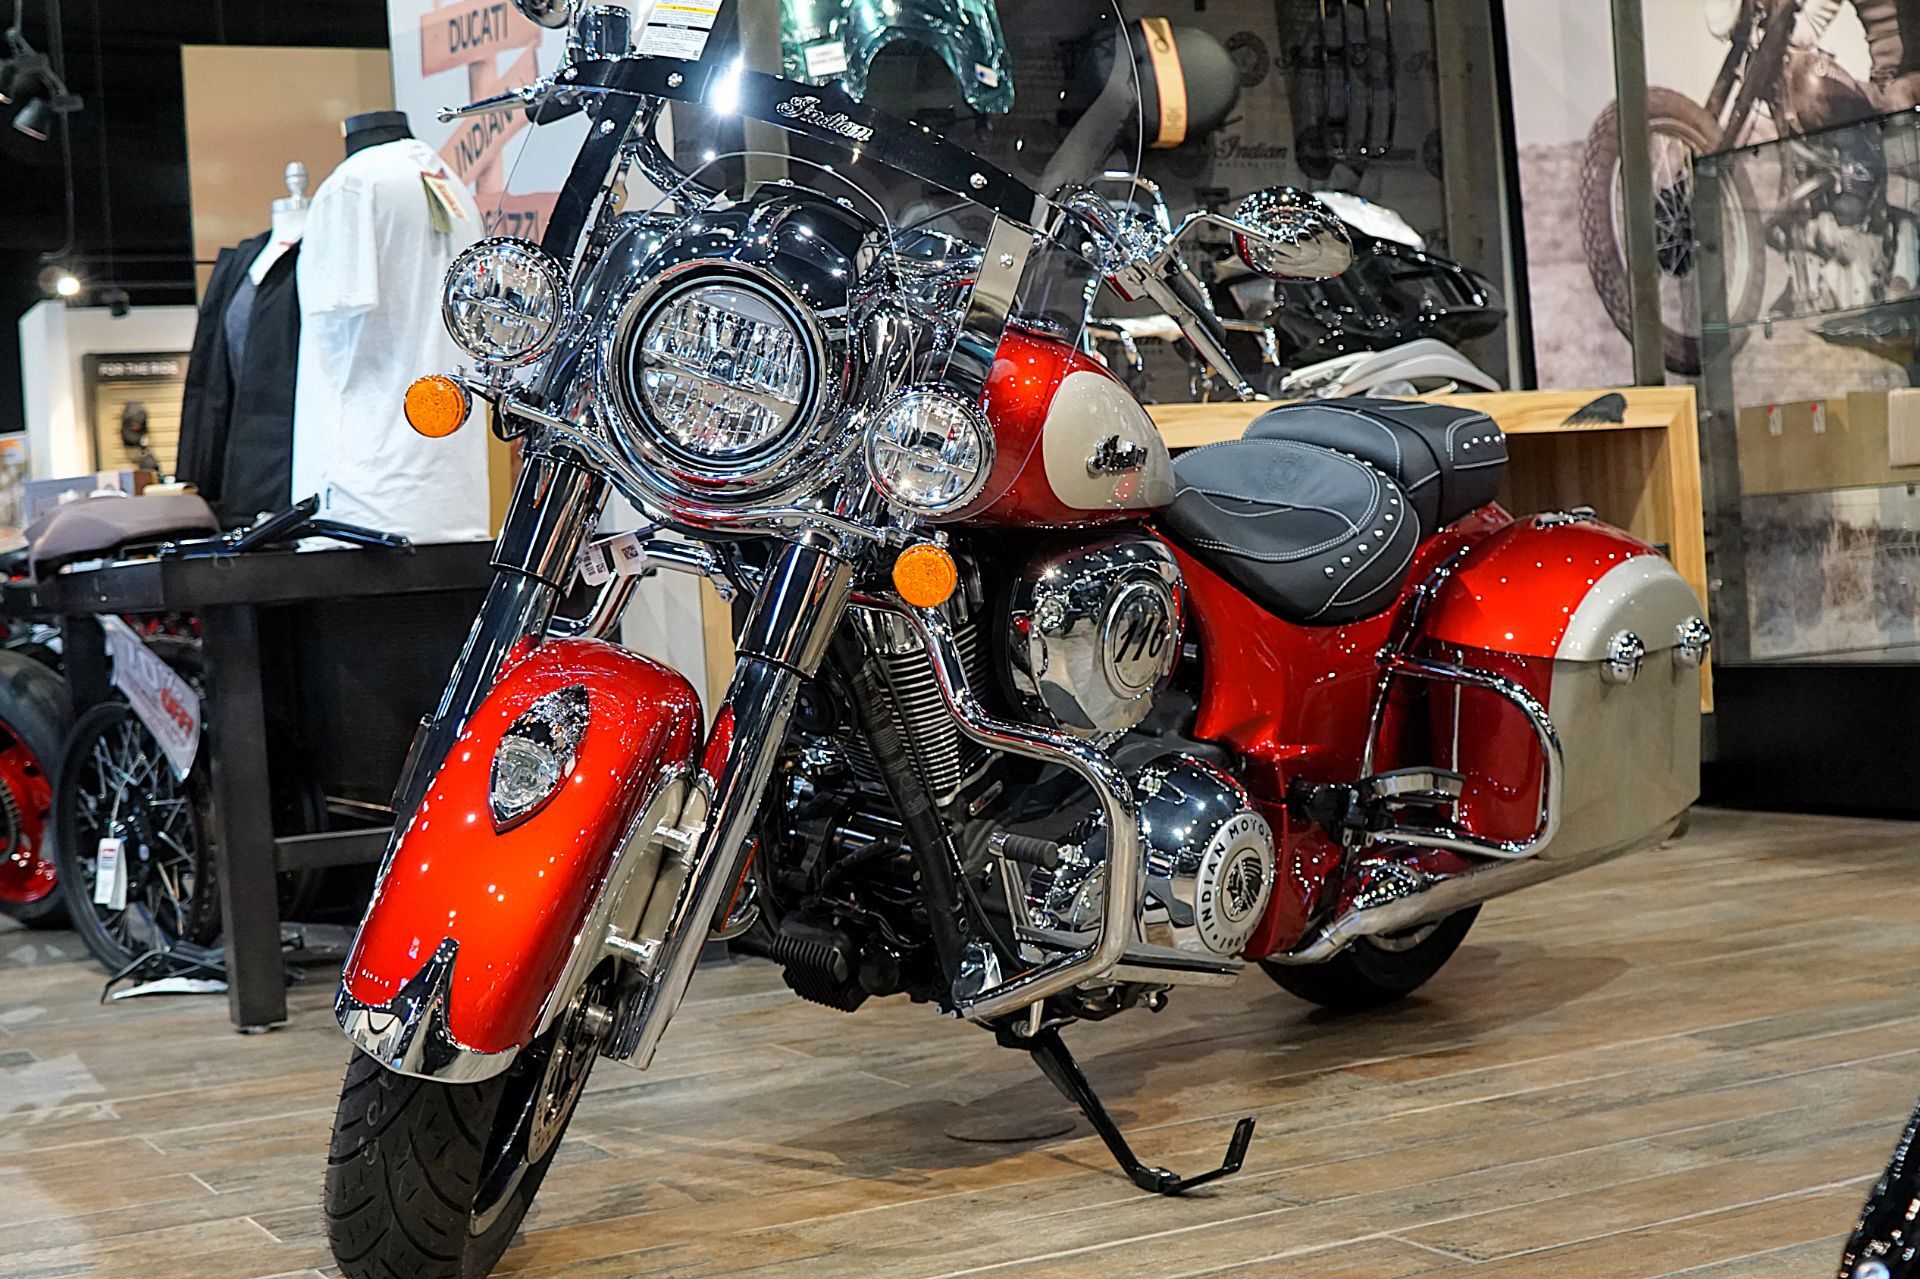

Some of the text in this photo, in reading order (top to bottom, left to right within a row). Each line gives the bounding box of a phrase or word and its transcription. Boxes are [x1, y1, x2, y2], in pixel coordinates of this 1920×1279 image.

[448, 4, 508, 53] DUCATI
[776, 96, 874, 141] Indian
[456, 110, 513, 178] INDIAN
[1113, 617, 1169, 663] 116
[1201, 842, 1226, 932] INDIAN
